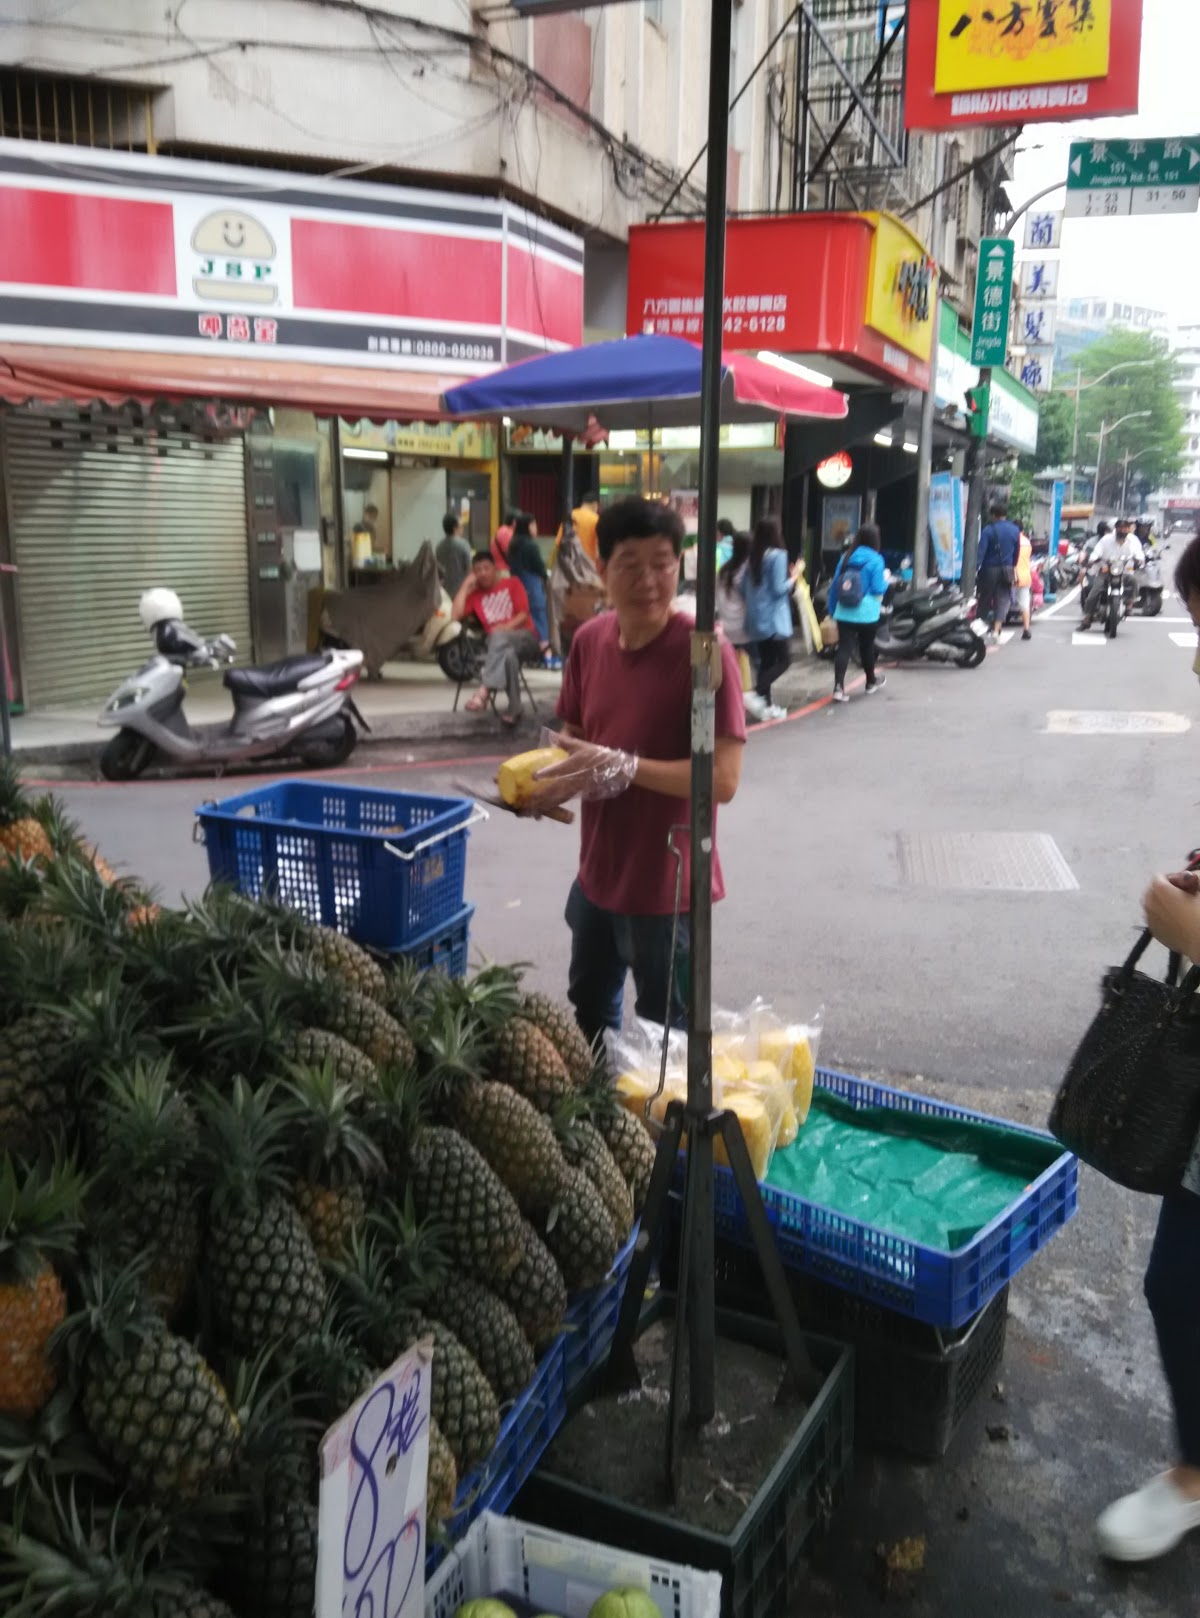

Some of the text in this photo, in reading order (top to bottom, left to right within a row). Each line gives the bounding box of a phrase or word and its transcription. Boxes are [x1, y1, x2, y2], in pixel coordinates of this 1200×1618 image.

[1090, 139, 1183, 163] 景平路
[981, 259, 1006, 332] 景德街
